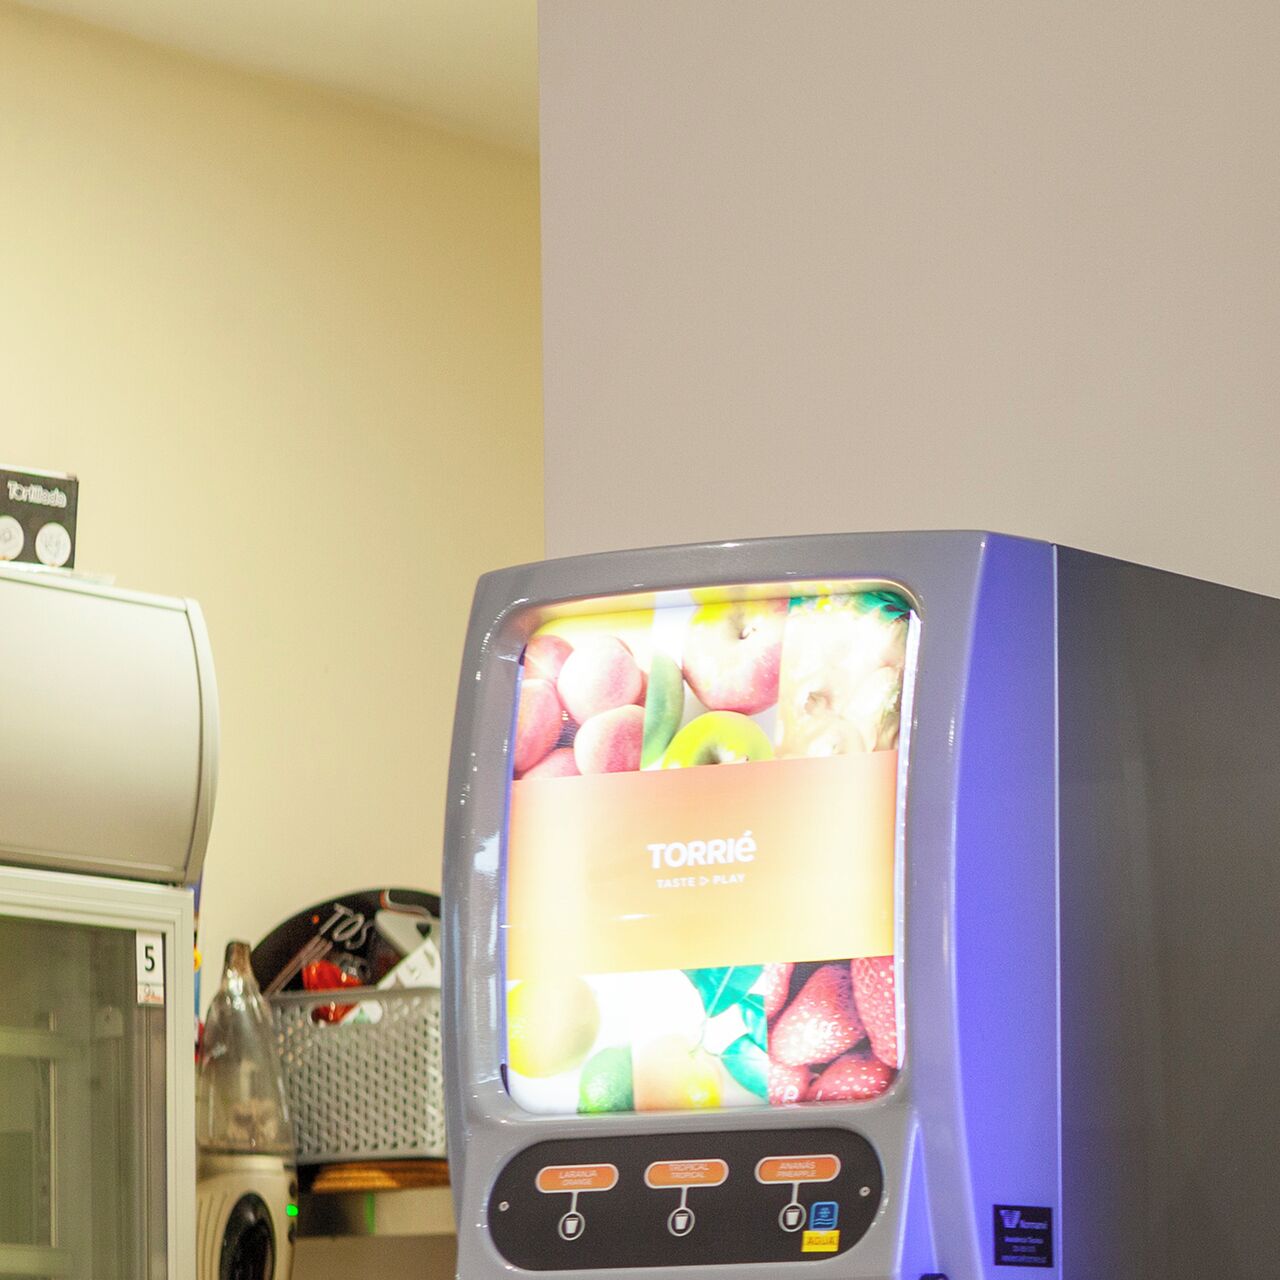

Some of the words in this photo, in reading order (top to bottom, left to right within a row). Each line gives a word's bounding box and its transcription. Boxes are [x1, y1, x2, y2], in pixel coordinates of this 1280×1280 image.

[656, 877, 696, 888] TASTE
[712, 873, 746, 885] PLAY
[145, 946, 155, 971] 5
